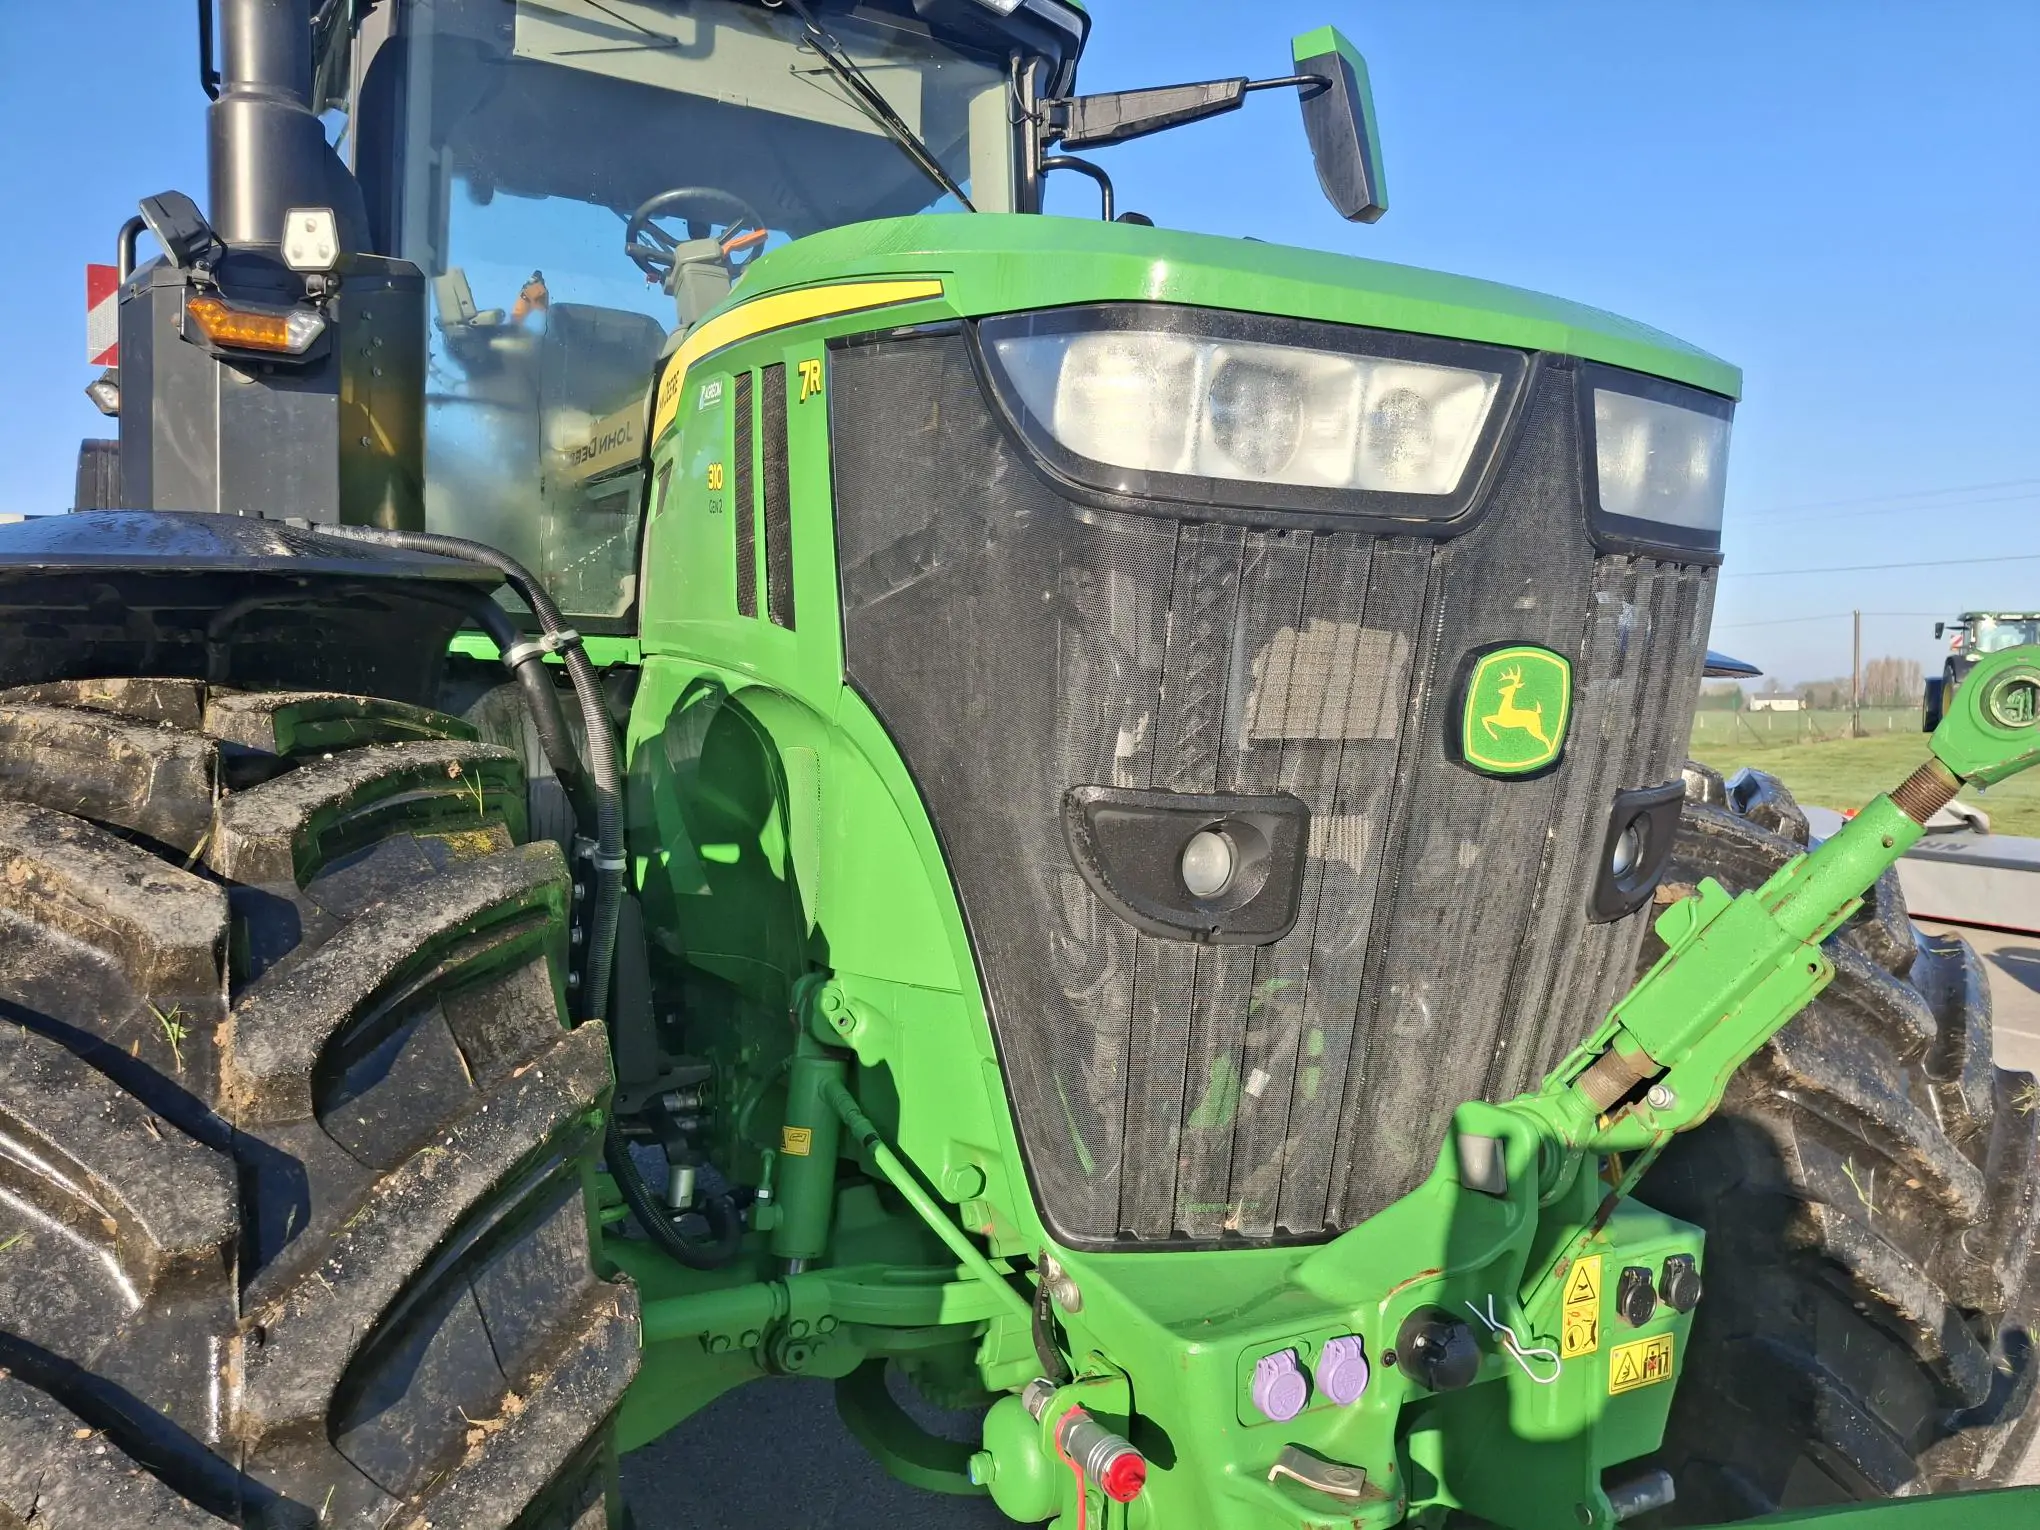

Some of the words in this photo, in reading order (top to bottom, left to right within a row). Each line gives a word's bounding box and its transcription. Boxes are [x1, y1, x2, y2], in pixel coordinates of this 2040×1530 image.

[798, 359, 821, 404] 7R
[708, 463, 723, 490] 310
[718, 498, 723, 513] 2
